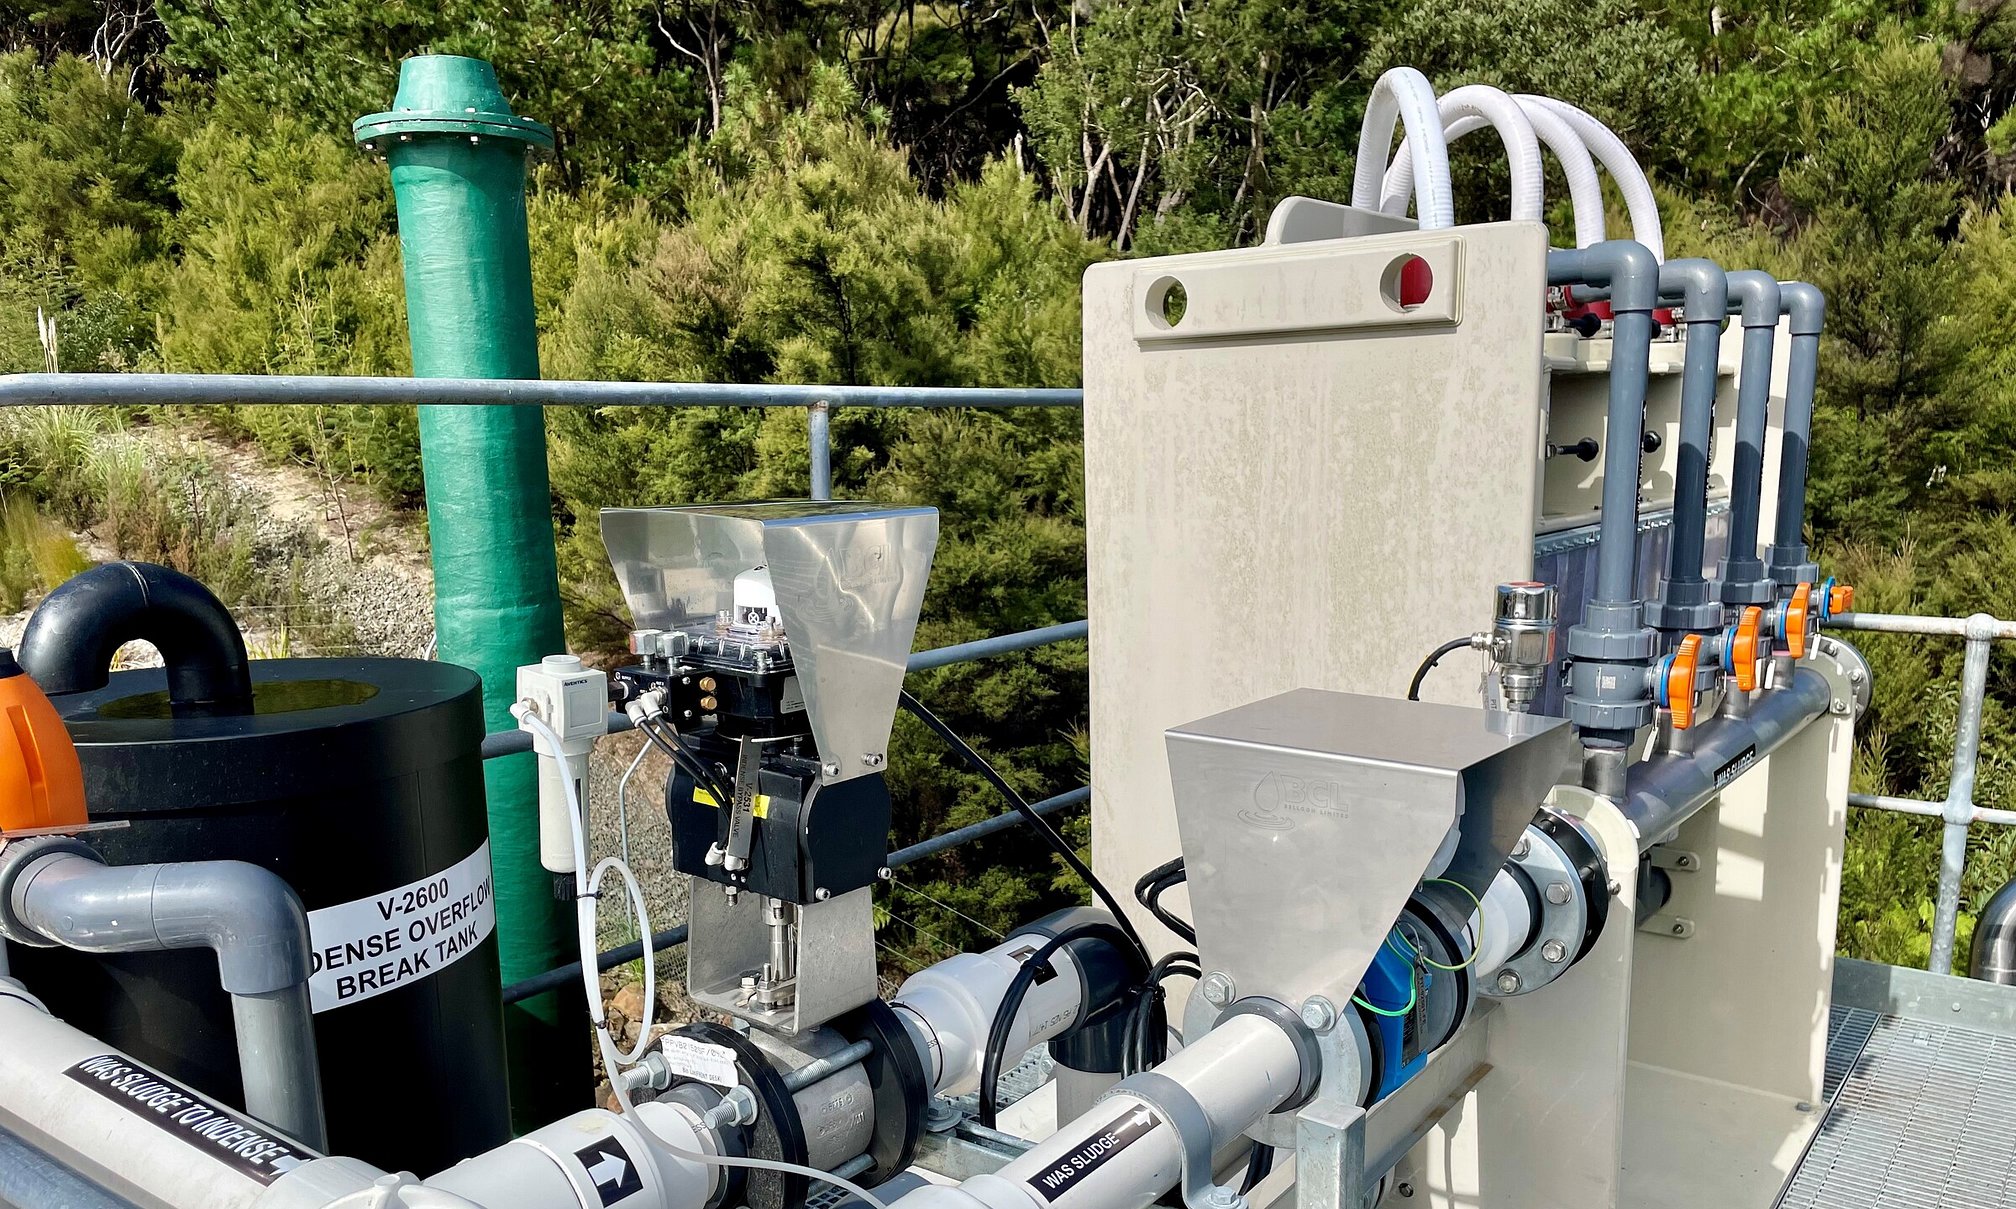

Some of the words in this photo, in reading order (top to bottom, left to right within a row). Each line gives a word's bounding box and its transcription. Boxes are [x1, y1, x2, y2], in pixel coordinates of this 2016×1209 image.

[735, 787, 744, 815] BYPASS
[742, 782, 753, 813] V-2531
[1280, 774, 1349, 812] BCL
[732, 816, 741, 838] VALVE
[376, 877, 449, 921] V-2600
[408, 875, 491, 942] OVERFLOW
[336, 948, 431, 1001] BREAK
[434, 920, 479, 962] TANK
[78, 1055, 119, 1082] WAS
[111, 1071, 192, 1114] SLUDGE
[170, 1102, 214, 1125] TO
[191, 1115, 291, 1165] INDENSE
[1042, 1164, 1075, 1189] WAS
[1070, 1132, 1120, 1170] SLUDGE
